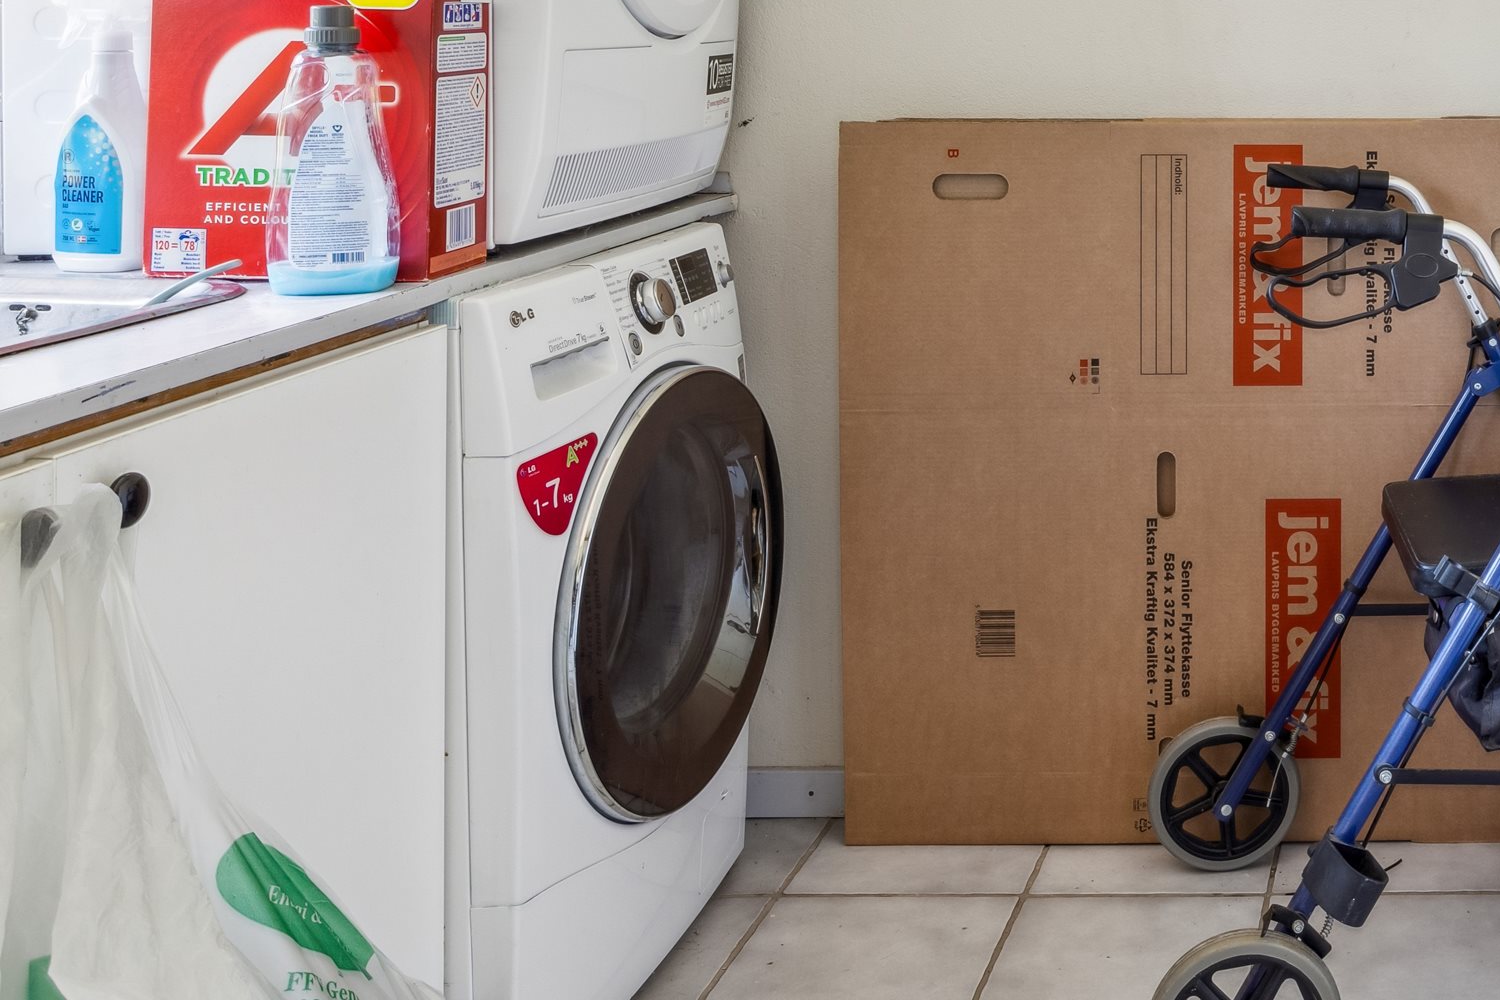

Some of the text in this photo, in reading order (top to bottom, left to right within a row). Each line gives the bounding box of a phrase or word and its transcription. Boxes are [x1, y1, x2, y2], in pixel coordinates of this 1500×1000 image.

[709, 59, 719, 90] 10
[948, 149, 960, 159] B
[62, 175, 96, 189] POWER
[1174, 158, 1183, 196] Indhold:
[62, 189, 104, 203] CLEANER
[206, 201, 282, 213] EFFICIENT
[203, 214, 289, 226] AND COLOU
[154, 240, 170, 251] 120
[184, 240, 196, 251] 78
[1238, 193, 1247, 325] LAVPRIS BYGGEMARKED
[521, 308, 535, 322] LG
[1252, 312, 1292, 373] fix
[1366, 335, 1378, 344] 7
[1366, 350, 1375, 377] mm
[527, 464, 537, 474] LG
[563, 493, 574, 503] kg
[1146, 517, 1158, 566] Ekstra
[1278, 512, 1329, 615] jem
[1144, 571, 1158, 622] Kraftig
[1164, 553, 1175, 706] 584 x 372 x 374 mm
[1179, 560, 1193, 698] Senior Flyttekasse
[1271, 551, 1280, 693] LAVPRIS BYGGEMARKED
[1146, 626, 1158, 684] Kvalitet
[1147, 700, 1158, 708] 7
[1146, 713, 1156, 741] mm
[284, 971, 360, 1000] FF Gen
